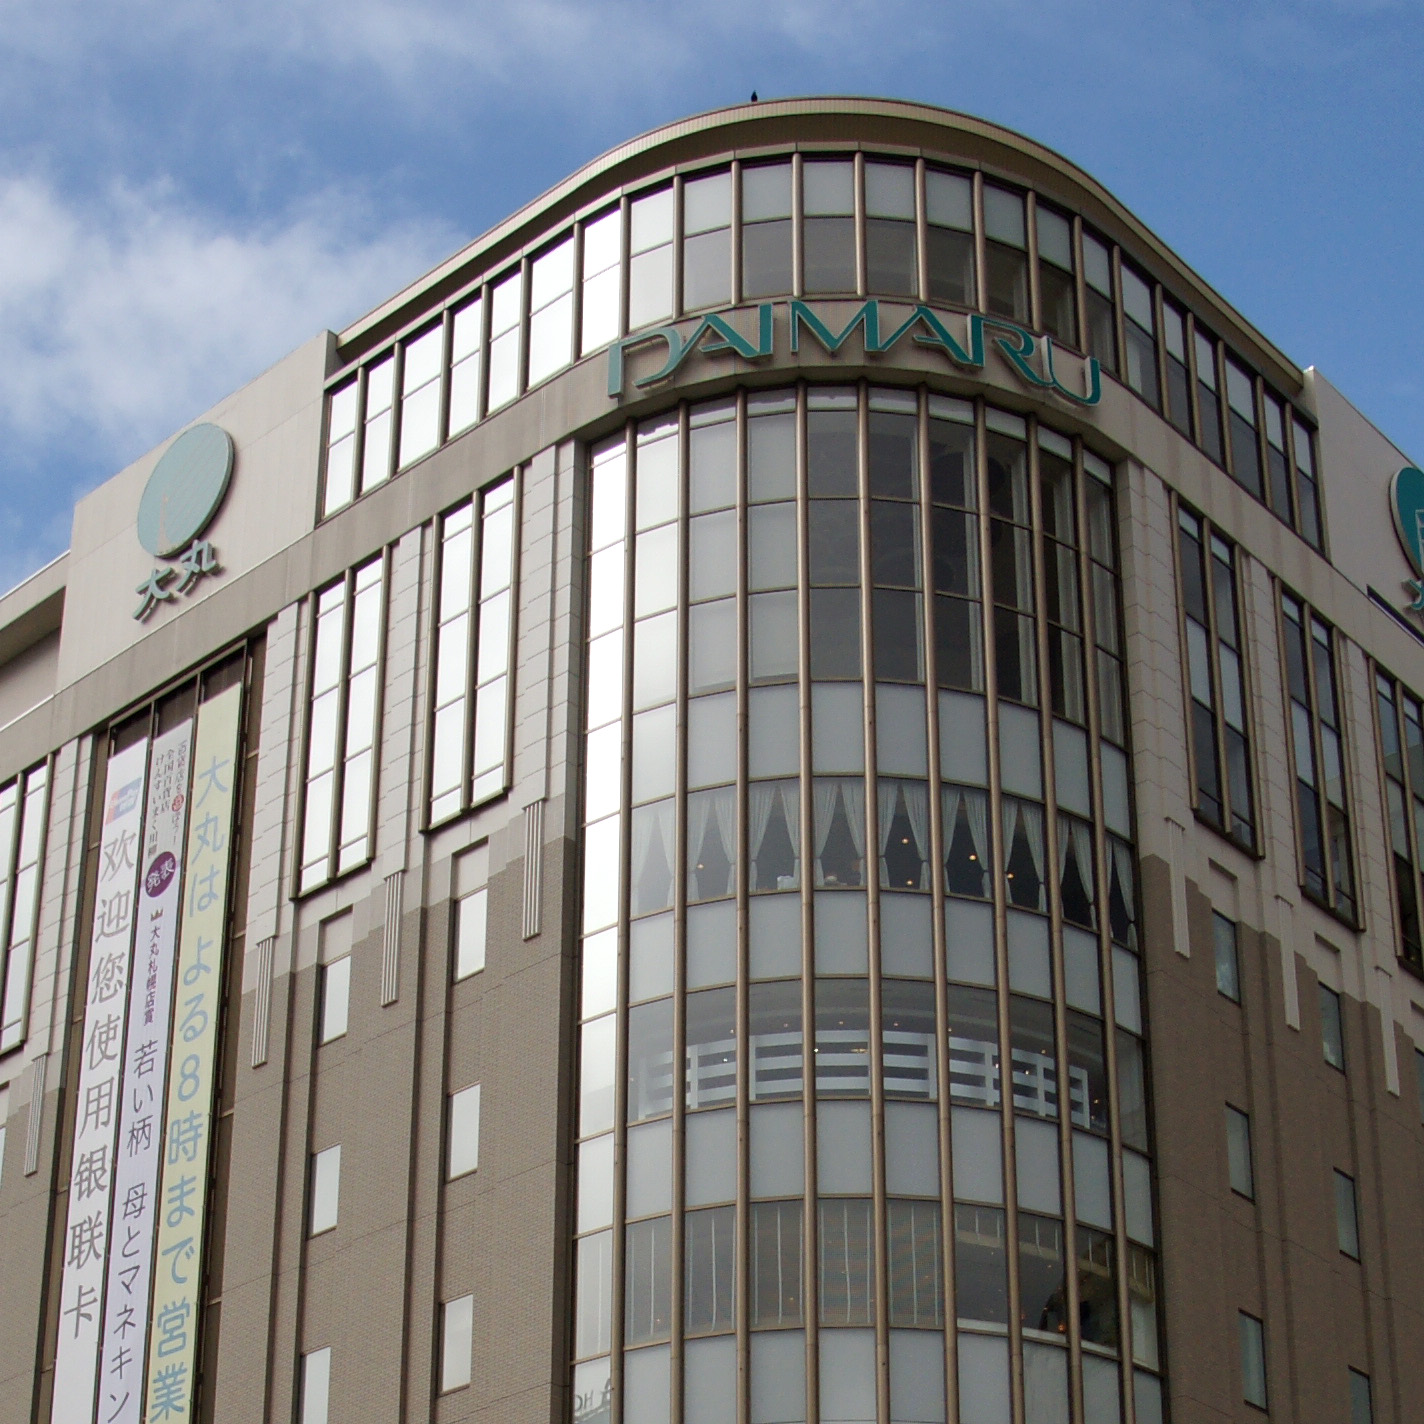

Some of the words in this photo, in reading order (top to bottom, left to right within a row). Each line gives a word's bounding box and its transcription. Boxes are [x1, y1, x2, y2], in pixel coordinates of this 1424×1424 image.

[606, 299, 1101, 406] DAIMARU
[132, 539, 219, 622] 大丸
[146, 857, 176, 892] 発表
[143, 925, 161, 1026] 大丸札幌店賞
[64, 829, 137, 1339] 欢迎您使用银联卡
